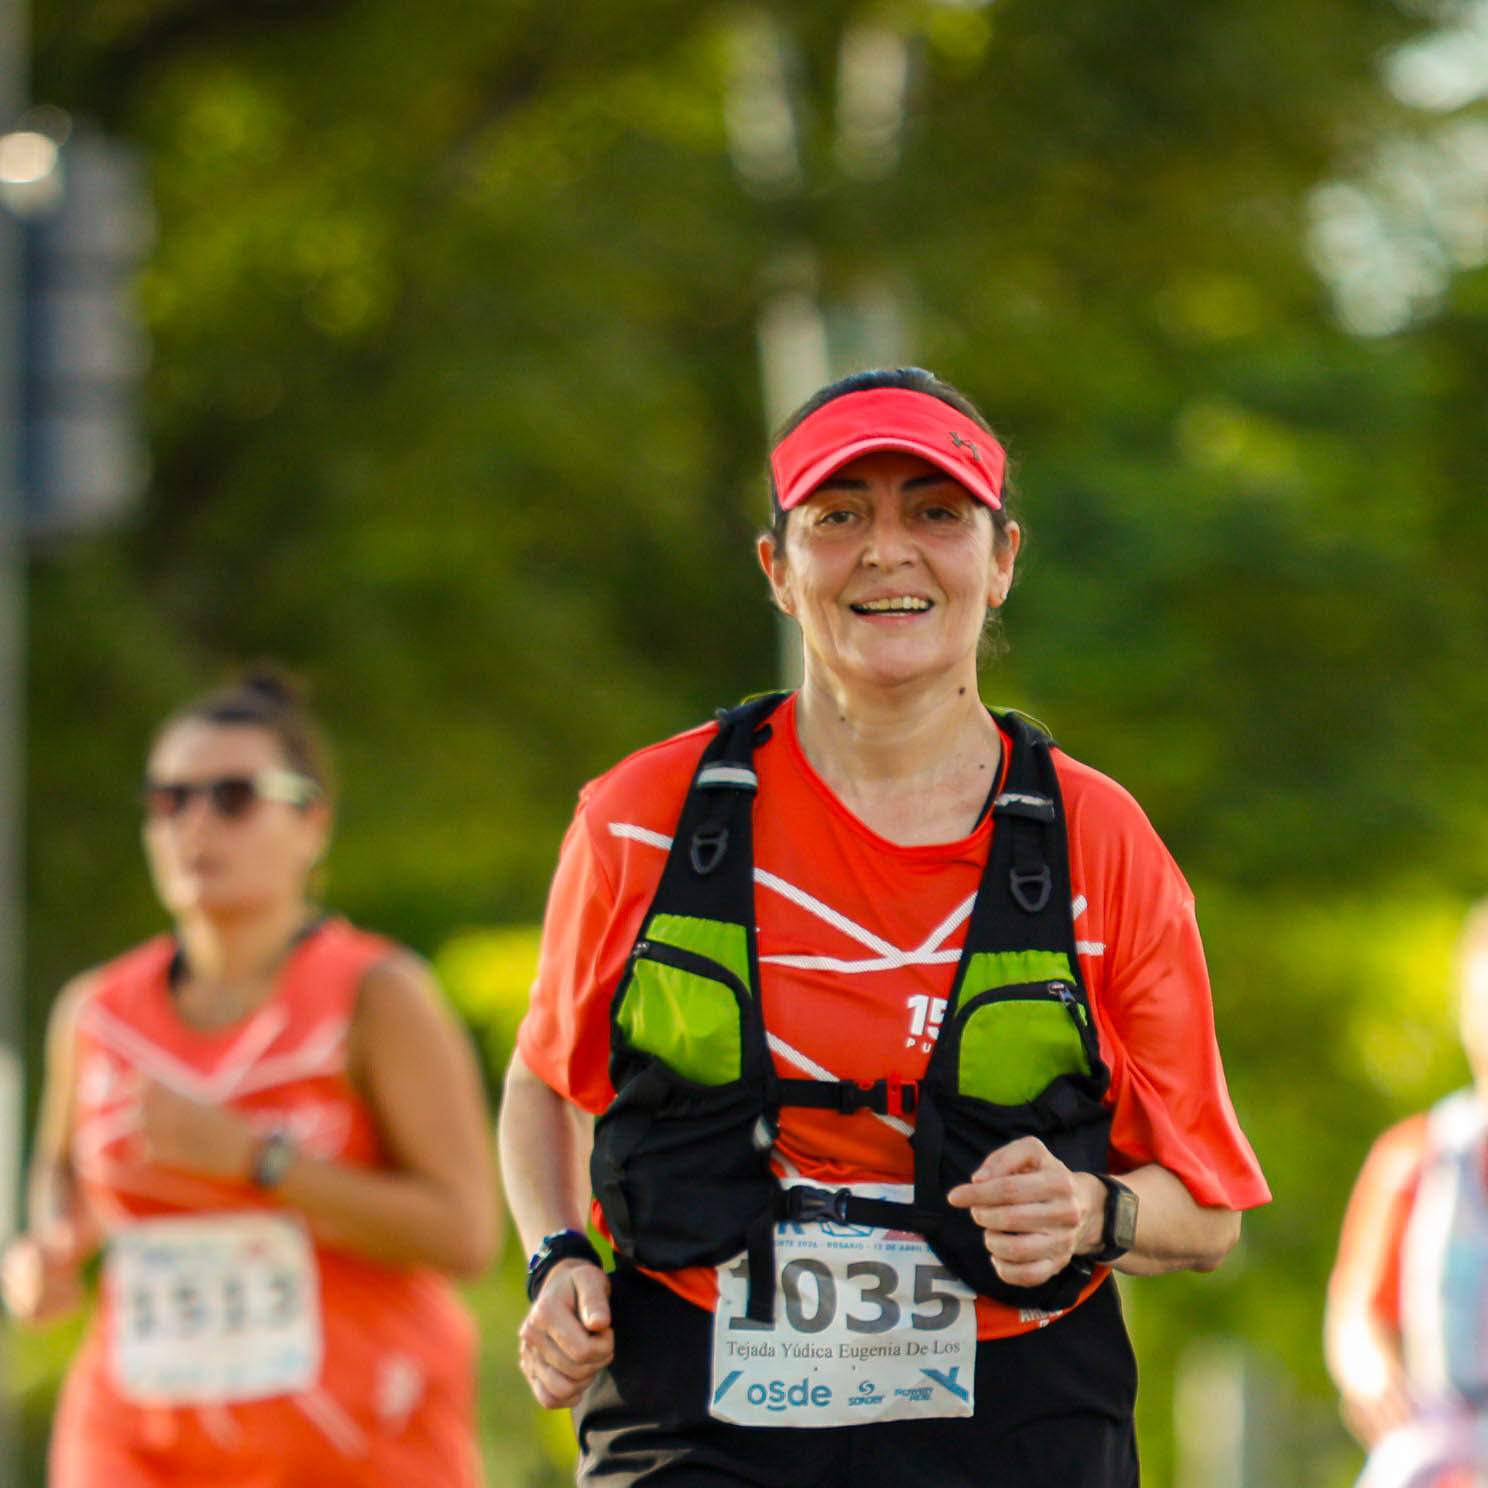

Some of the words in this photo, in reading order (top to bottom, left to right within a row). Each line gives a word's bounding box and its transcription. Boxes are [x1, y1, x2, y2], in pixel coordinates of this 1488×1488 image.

[726, 1340, 776, 1361] Tejada
[781, 1342, 833, 1359] Yúdica
[838, 1343, 902, 1361] Eugenia
[907, 1341, 929, 1356] De
[932, 1339, 961, 1355] Los
[746, 1377, 833, 1408] osde
